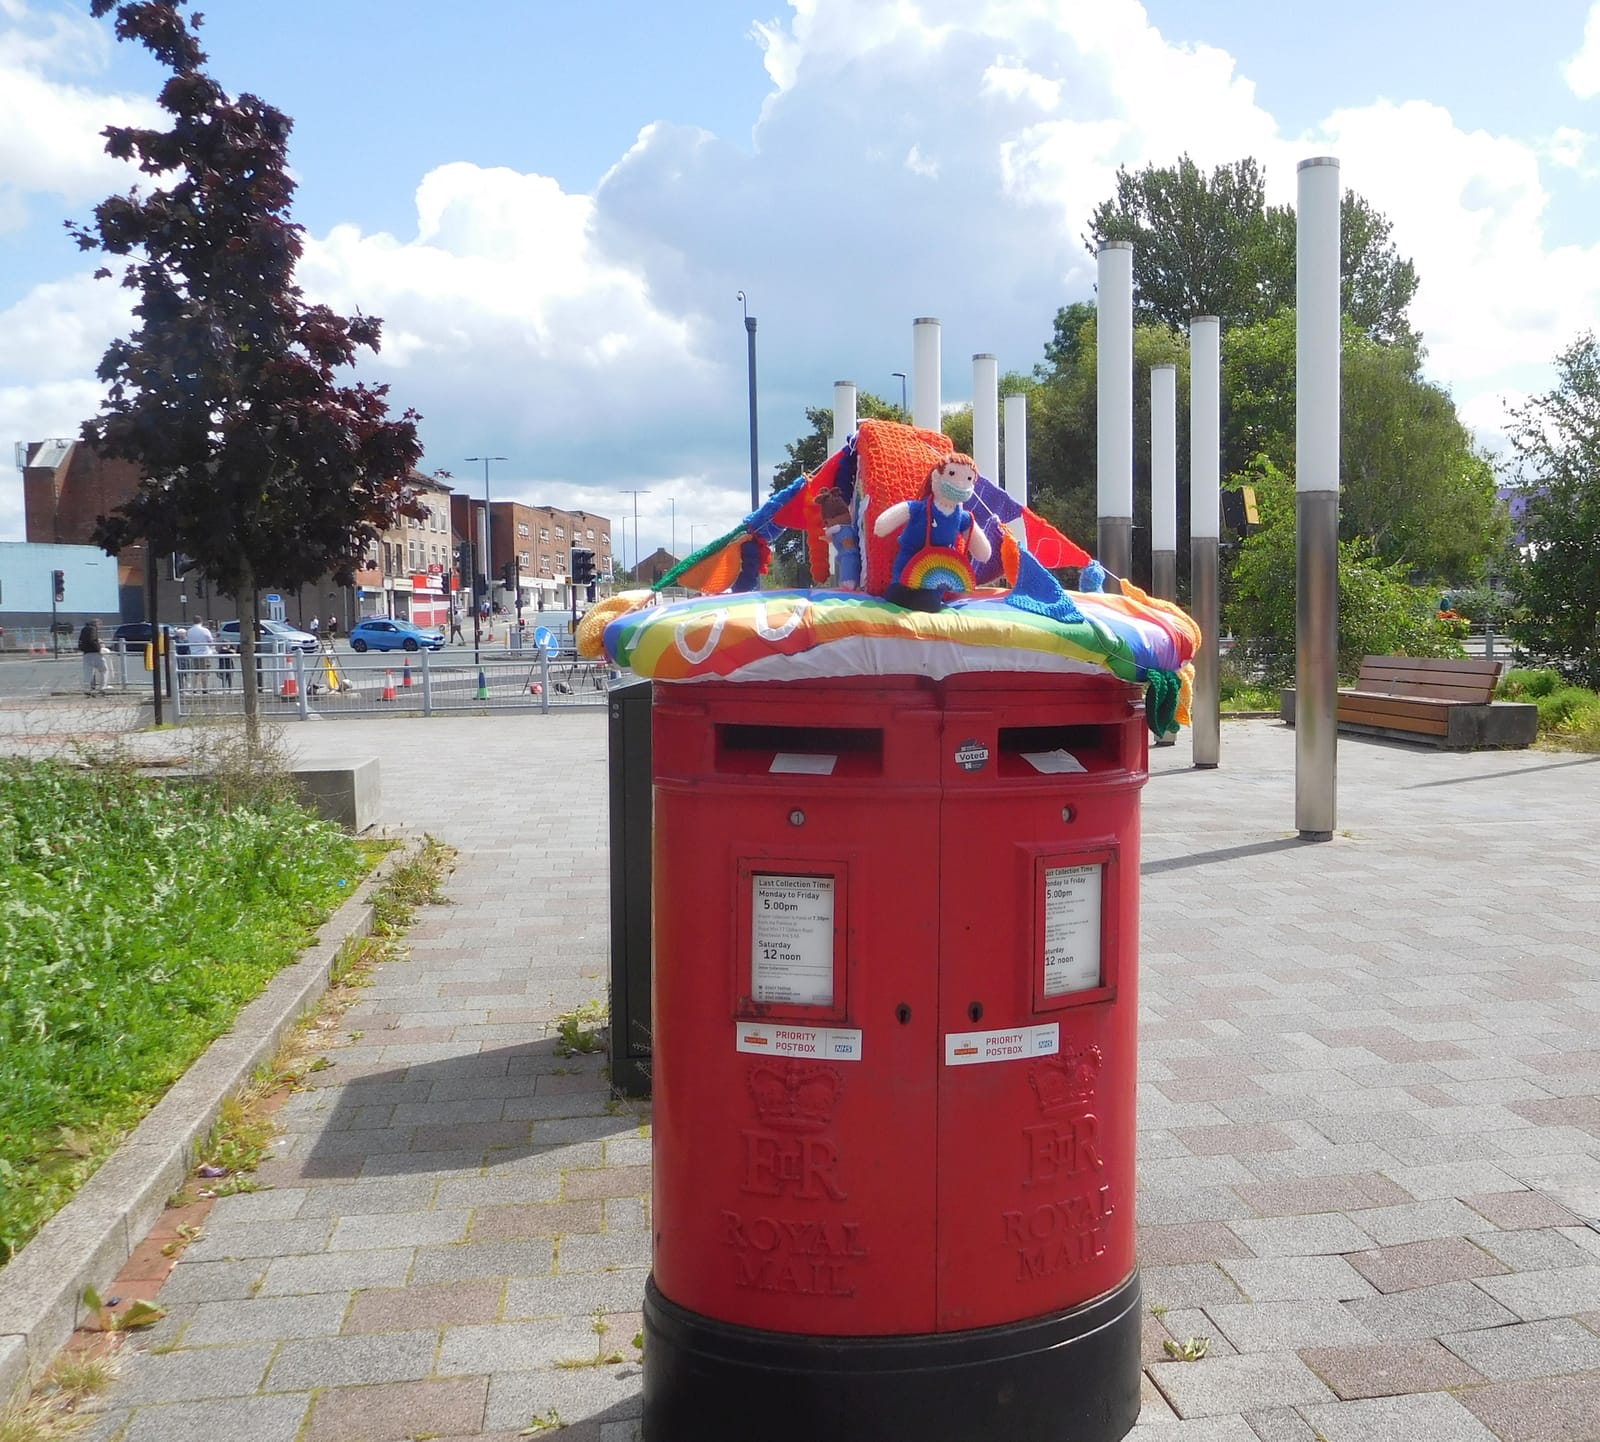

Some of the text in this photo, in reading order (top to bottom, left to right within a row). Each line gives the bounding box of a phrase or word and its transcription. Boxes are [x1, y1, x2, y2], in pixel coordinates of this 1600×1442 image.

[959, 751, 985, 761] Voted
[1055, 868, 1080, 876] Collection
[758, 879, 831, 889] Last Collection Time
[1046, 879, 1063, 888] onday
[1070, 877, 1087, 885] Friday
[758, 890, 786, 900] Monday
[796, 892, 820, 901] Friday
[1046, 889, 1073, 899] 5.00pm
[763, 899, 799, 912] 5.00pm
[758, 940, 792, 950] Saturday
[1046, 946, 1065, 955] aturday
[763, 948, 801, 961] 12 noon
[1045, 955, 1074, 967] 12 noon
[775, 1030, 817, 1042] PRIORITY
[985, 1034, 1024, 1046] PRIORITY
[775, 1042, 816, 1053] POSTBOX
[834, 1044, 853, 1053] NHS
[985, 1045, 1023, 1057] POSTBOX
[1002, 1184, 1116, 1245] ROYAL
[719, 1208, 871, 1257] ROYAL
[1015, 1226, 1108, 1283] MAIL
[735, 1252, 856, 1297] MAIL
